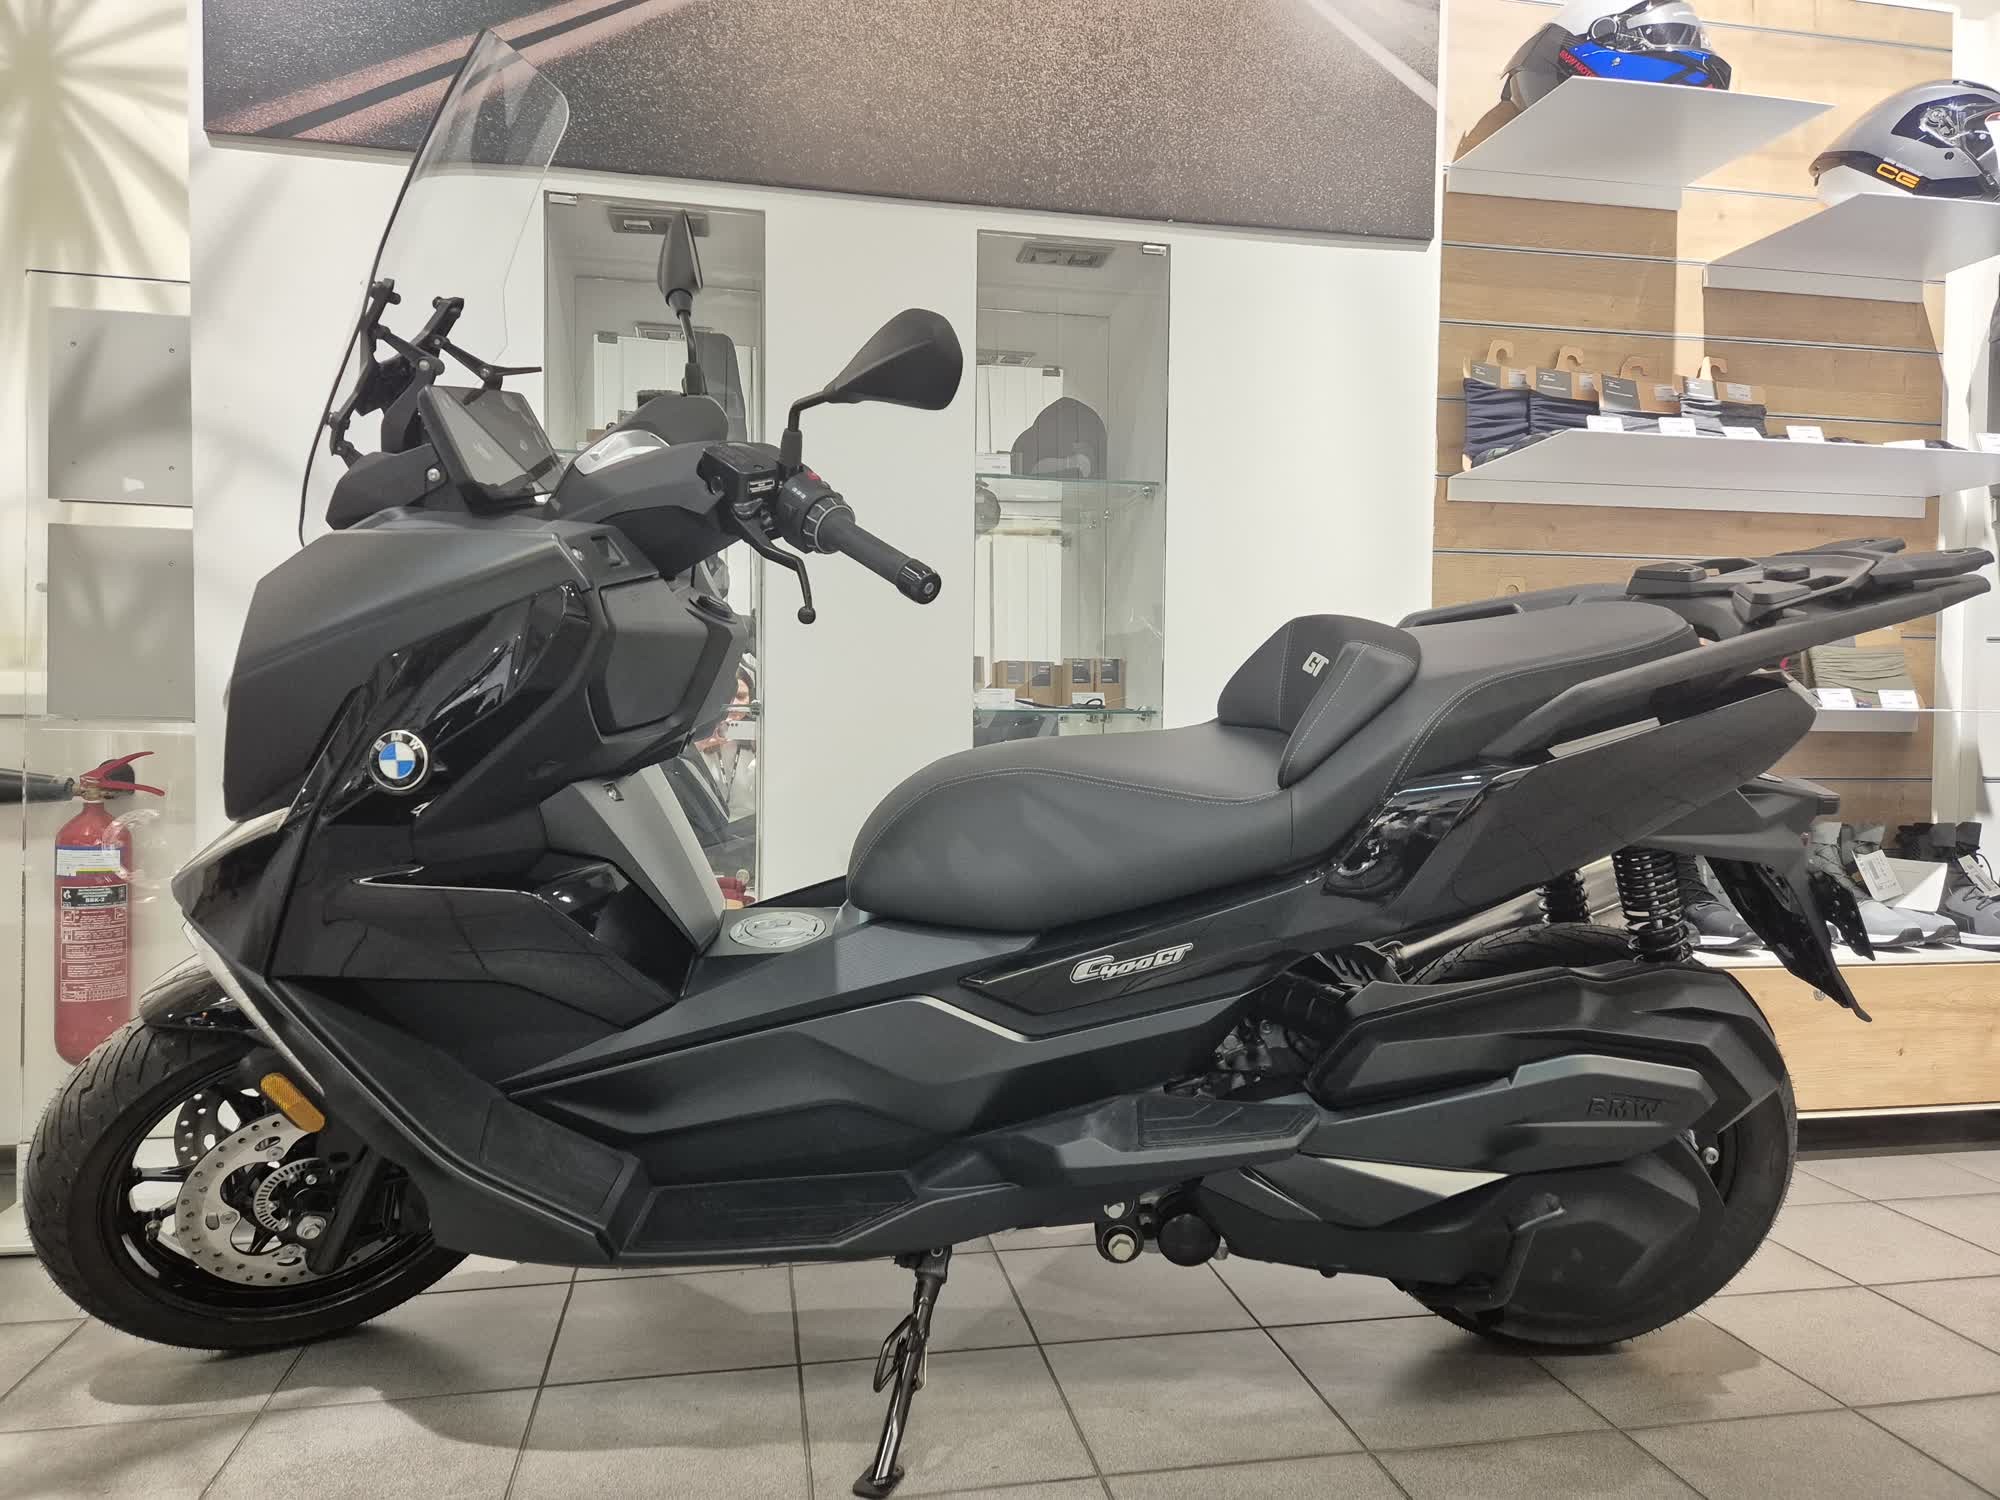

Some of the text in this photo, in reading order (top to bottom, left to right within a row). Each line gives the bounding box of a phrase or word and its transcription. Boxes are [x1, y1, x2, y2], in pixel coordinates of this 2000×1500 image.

[1302, 651, 1329, 677] GT
[373, 731, 421, 751] BMW
[1586, 1096, 1660, 1119] BMW
